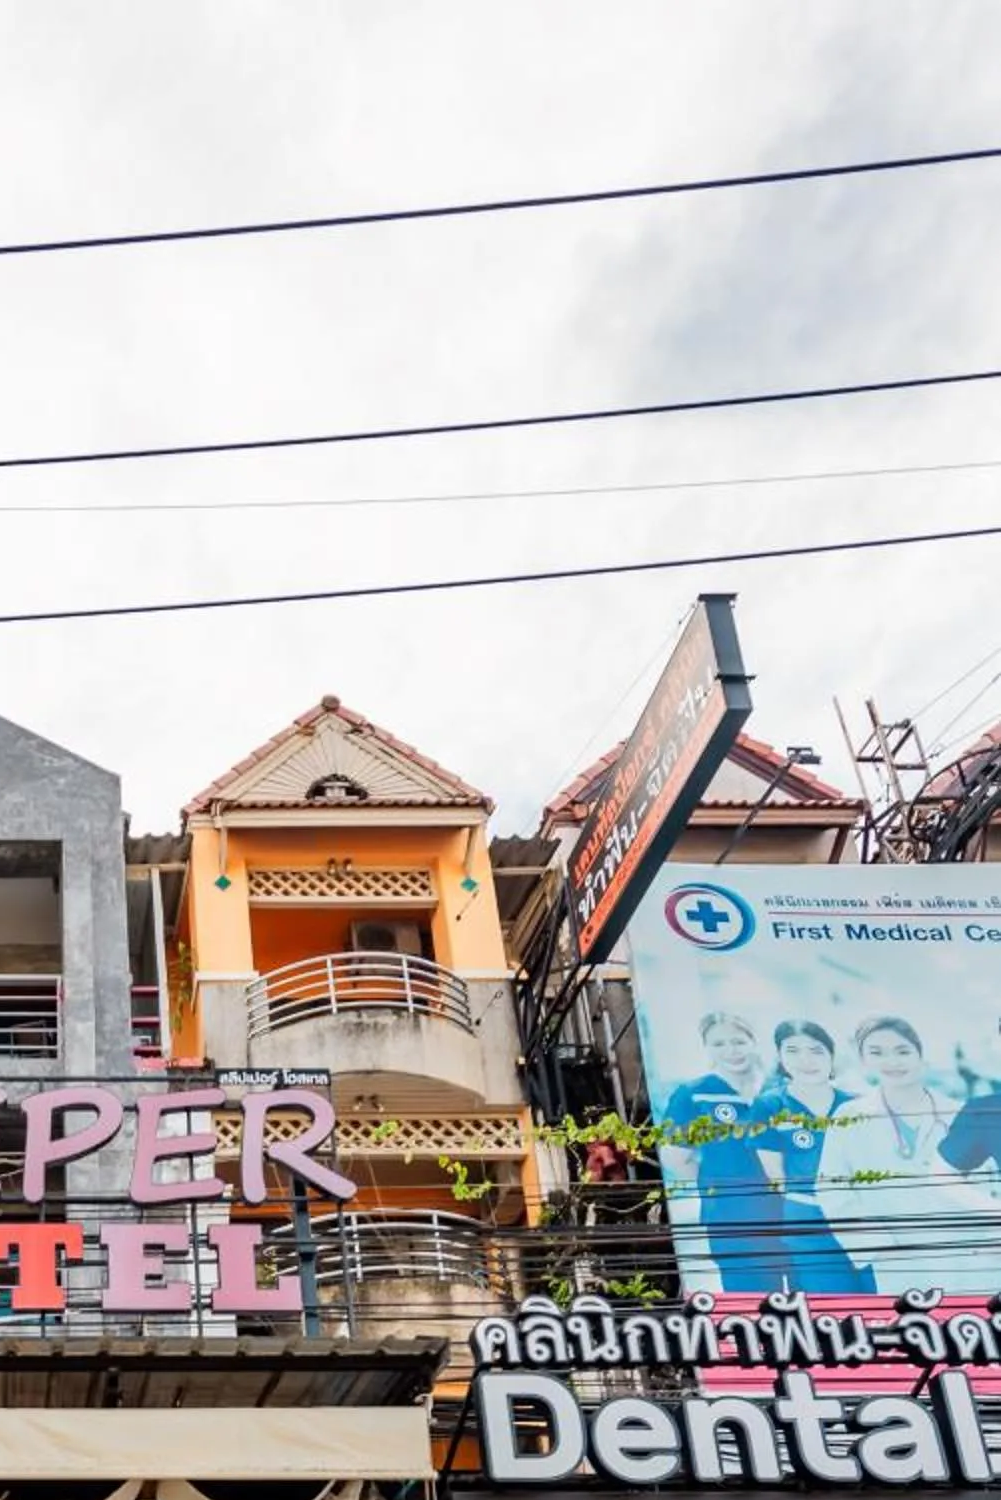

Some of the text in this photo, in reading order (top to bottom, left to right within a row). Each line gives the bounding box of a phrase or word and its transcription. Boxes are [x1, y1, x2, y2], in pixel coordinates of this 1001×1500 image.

[772, 921, 835, 941] First
[844, 923, 952, 942] Medical
[475, 1287, 1001, 1364] คลินิกทำฟัน-จัด
[478, 1369, 994, 1483] Dental
